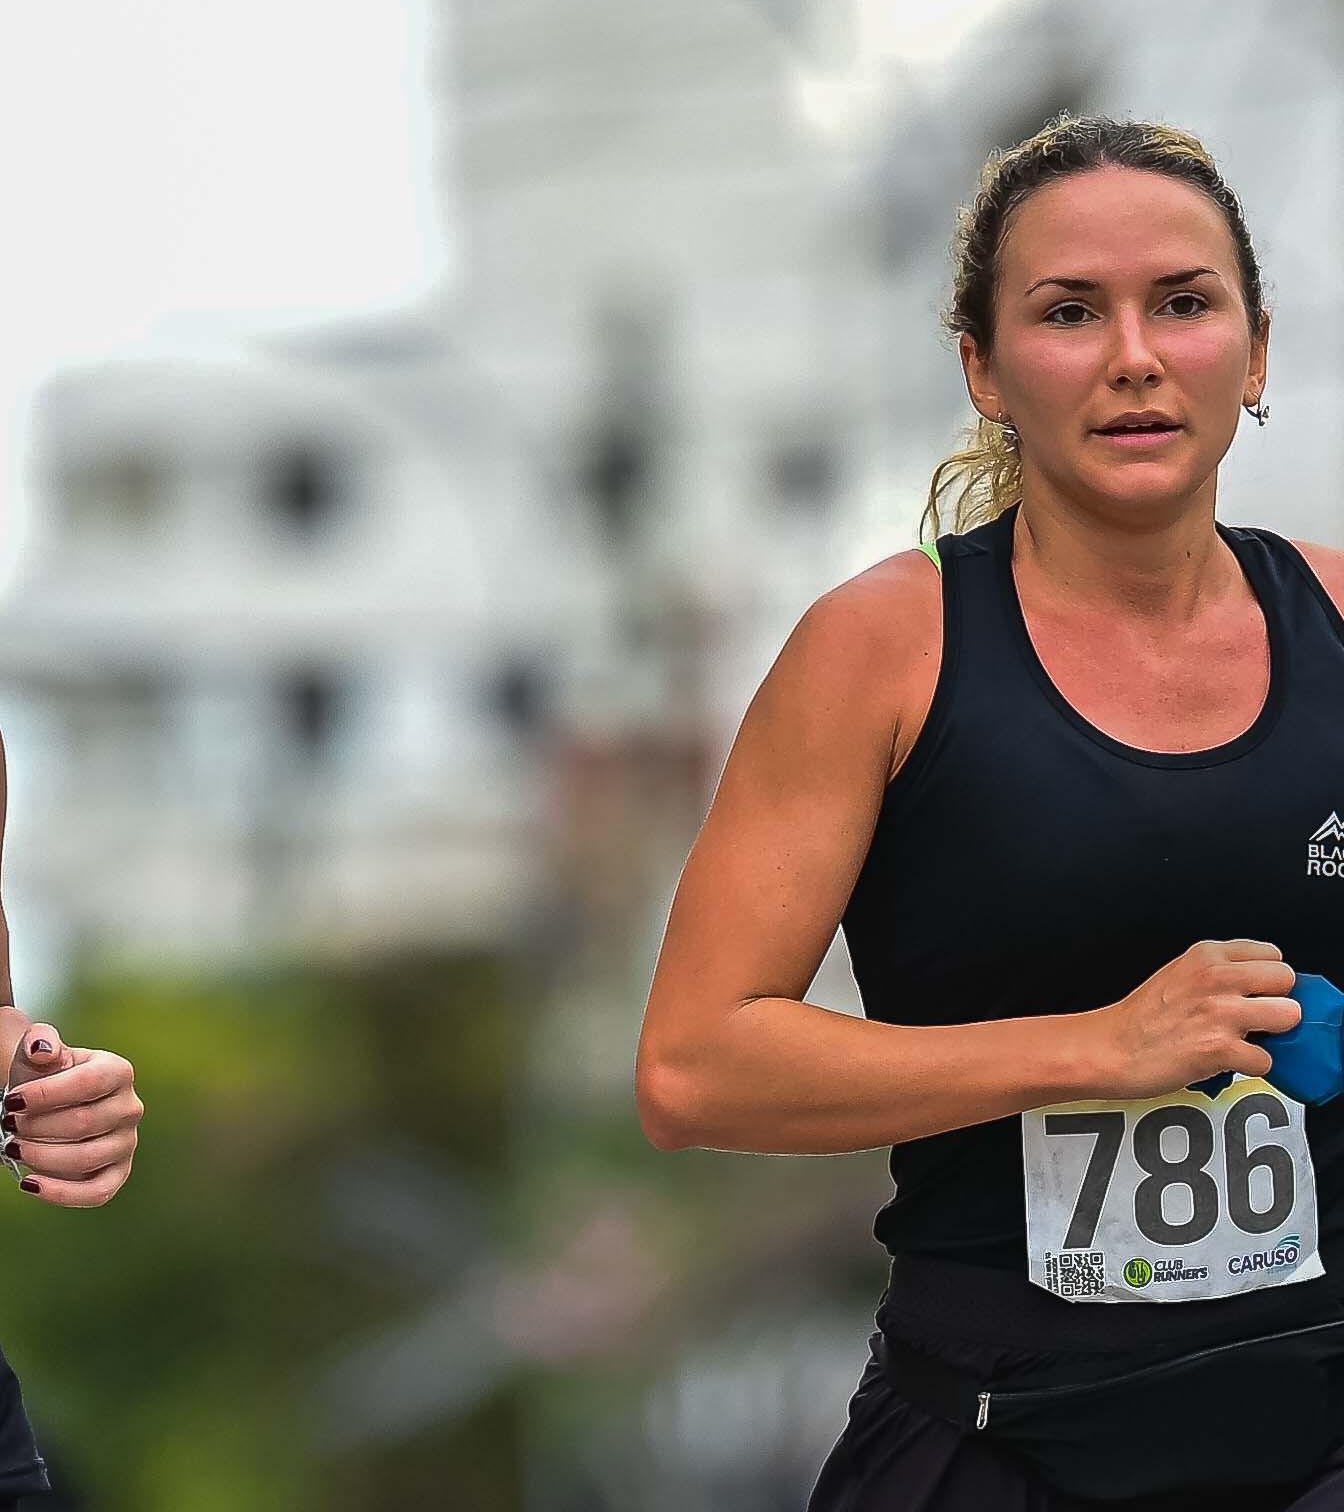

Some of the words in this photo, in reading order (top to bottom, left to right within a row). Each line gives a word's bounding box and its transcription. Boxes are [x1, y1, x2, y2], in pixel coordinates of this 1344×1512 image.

[1044, 1092, 1296, 1249] 786
[1154, 1259, 1184, 1272] CLUB
[1228, 1246, 1298, 1275] CARUSO
